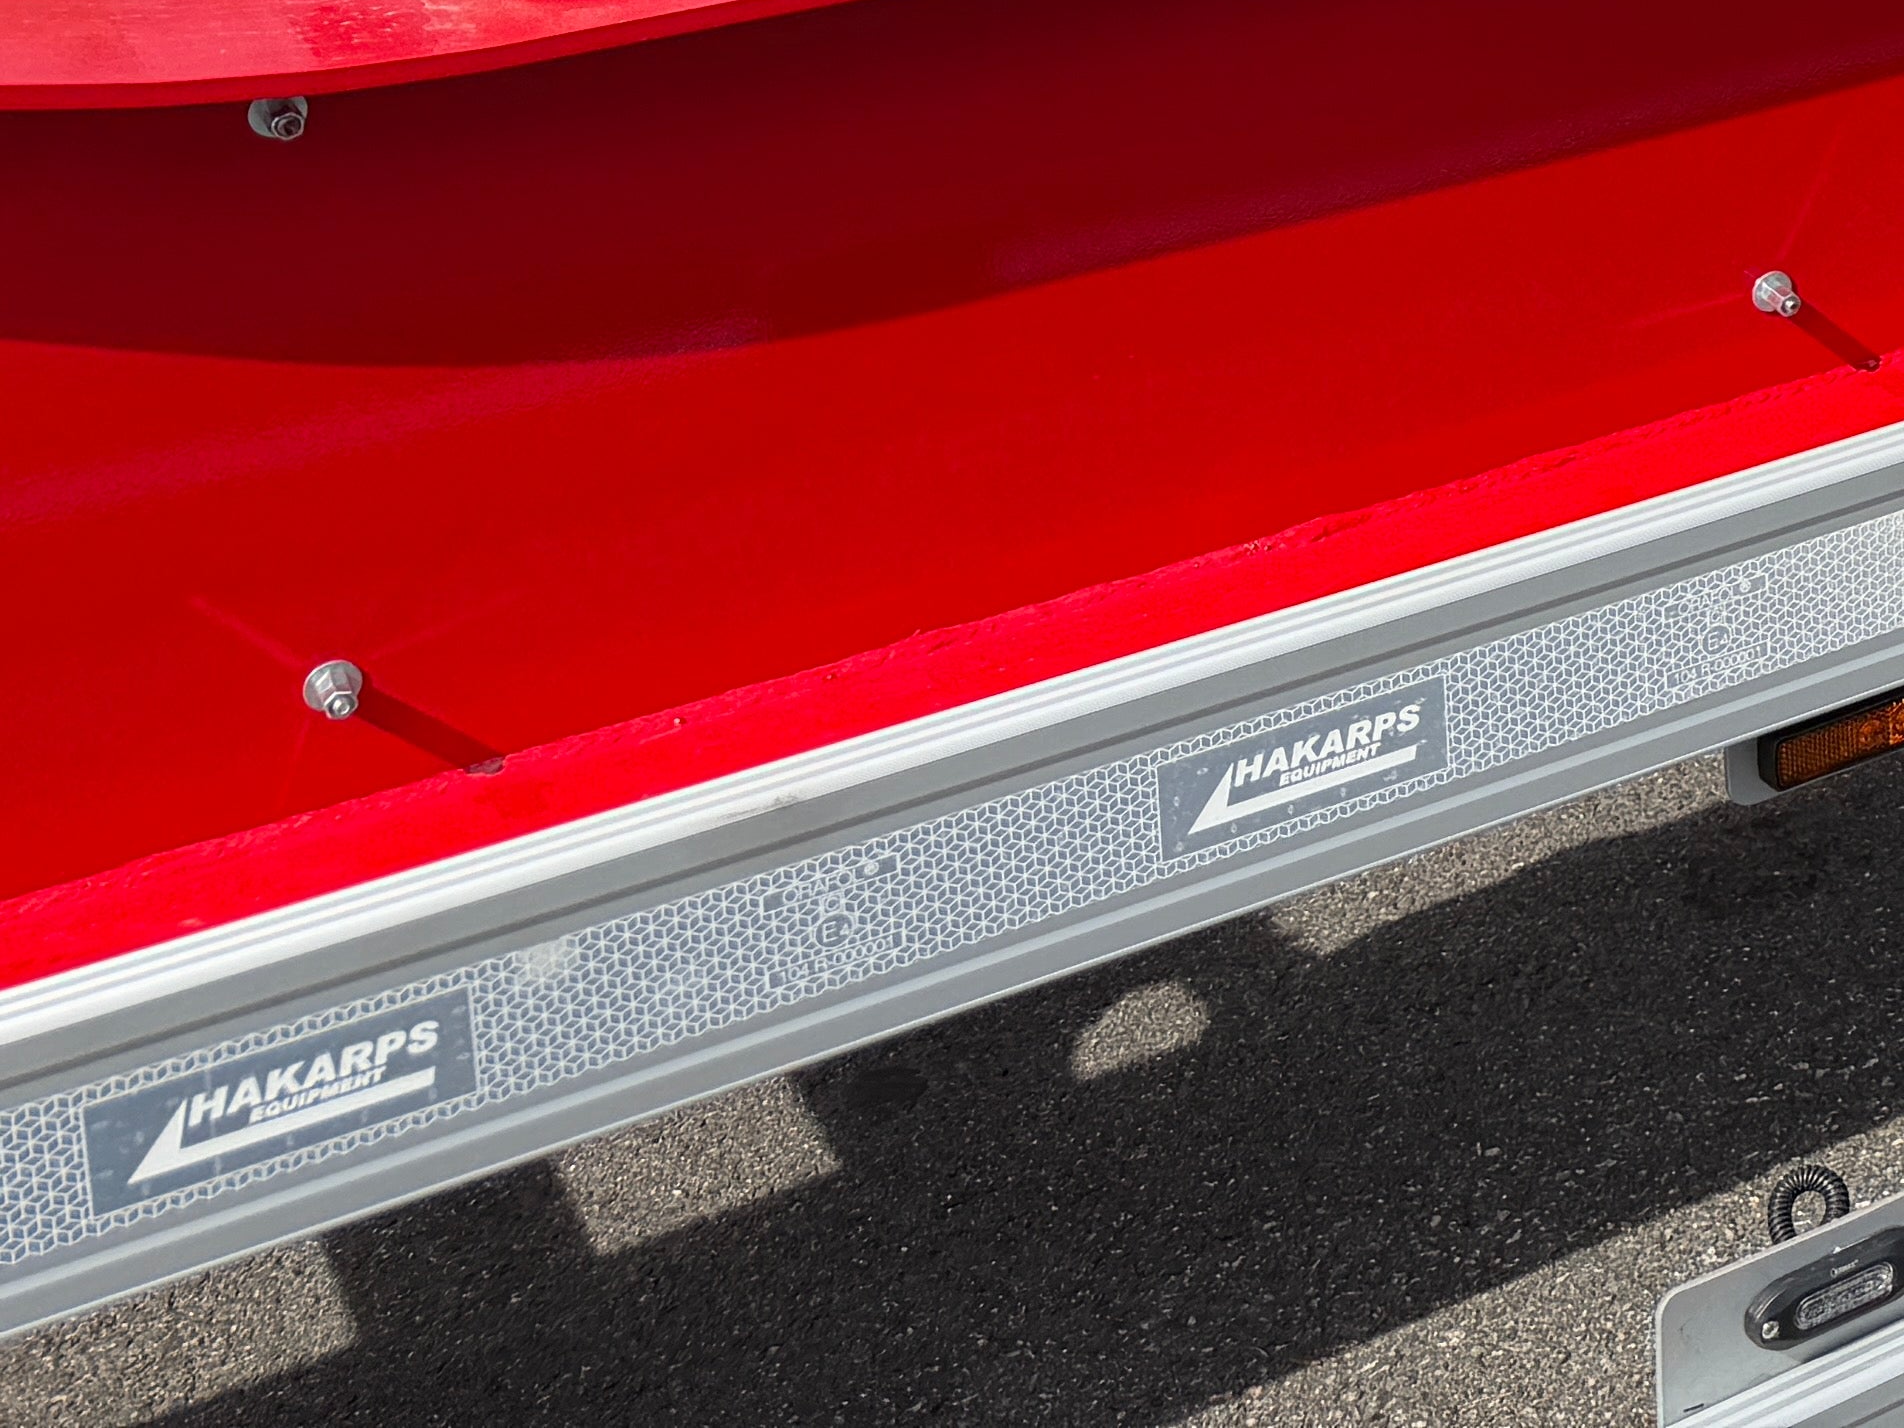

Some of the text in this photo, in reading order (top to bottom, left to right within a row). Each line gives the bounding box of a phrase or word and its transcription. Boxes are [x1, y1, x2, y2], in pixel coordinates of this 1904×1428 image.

[1233, 703, 1422, 787] HAKARPS
[1279, 742, 1382, 787] EQUIPMENT
[781, 962, 810, 983] 104
[187, 1019, 440, 1128] HAKARPS
[249, 1063, 389, 1125] EQUIPMENT
